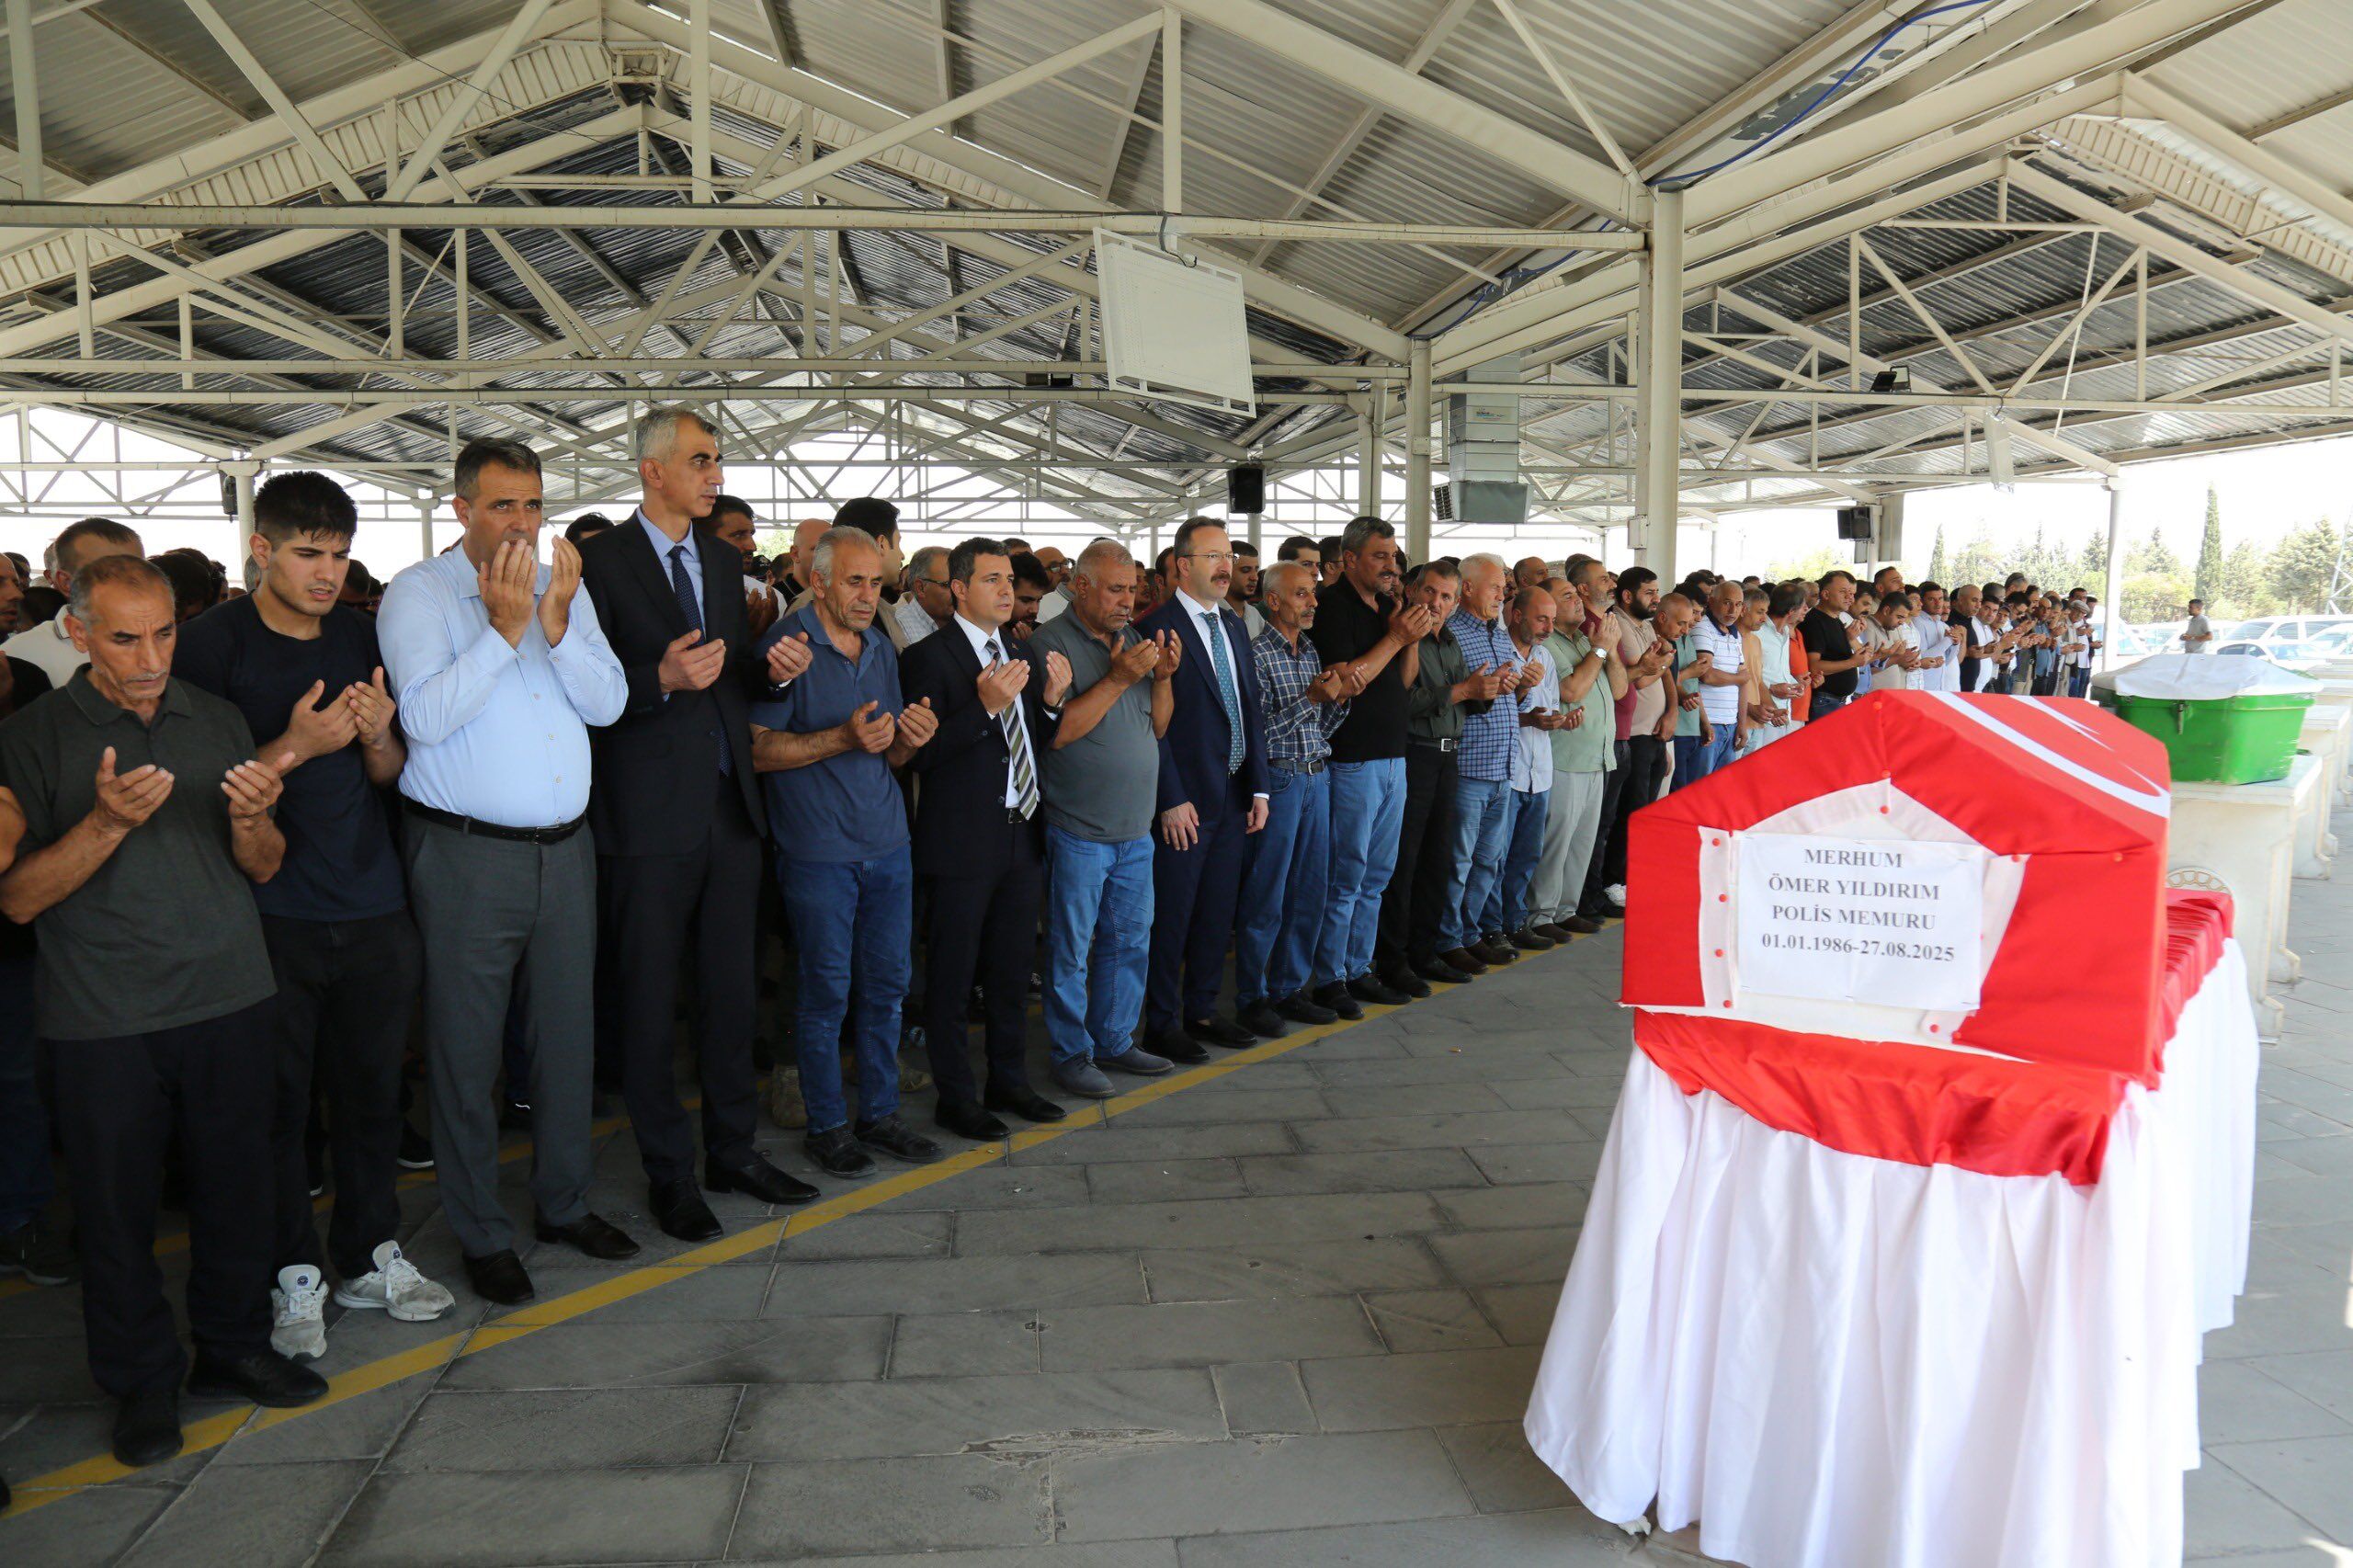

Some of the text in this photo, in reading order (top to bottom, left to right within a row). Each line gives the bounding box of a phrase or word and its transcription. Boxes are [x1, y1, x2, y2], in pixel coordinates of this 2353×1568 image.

[1804, 848, 1903, 869] MERHUM
[1768, 872, 1939, 900] ÖMER YILDIRIM
[1772, 903, 1936, 929] POLİS MEMURU
[1762, 933, 1955, 961] 01.01.1986-27.08.2025
